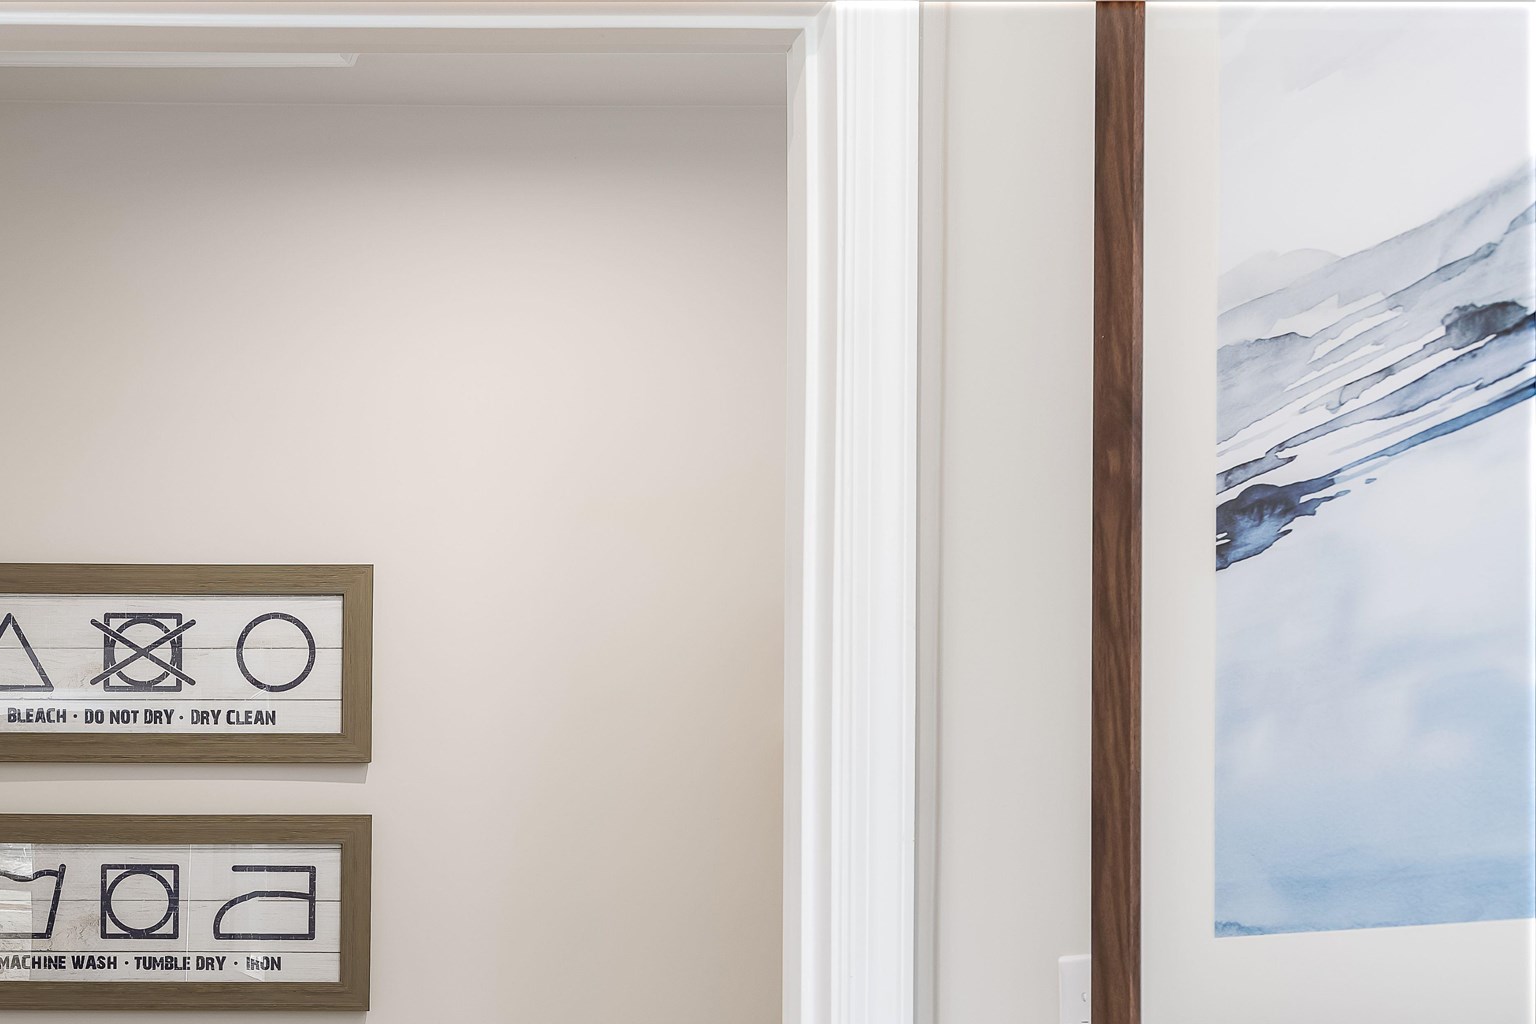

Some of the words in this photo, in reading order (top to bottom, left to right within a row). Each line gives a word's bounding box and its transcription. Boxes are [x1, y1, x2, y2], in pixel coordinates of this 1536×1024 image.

[7, 707, 66, 723] BLEACH
[84, 708, 105, 724] DO
[109, 709, 139, 724] NOT
[143, 708, 175, 725] DRY
[191, 709, 221, 725] DRY
[226, 709, 276, 726] CLEAN
[71, 955, 117, 970] WASH
[134, 956, 191, 971] TUMBLE
[196, 956, 227, 971] DRY
[246, 956, 282, 971] IRON
